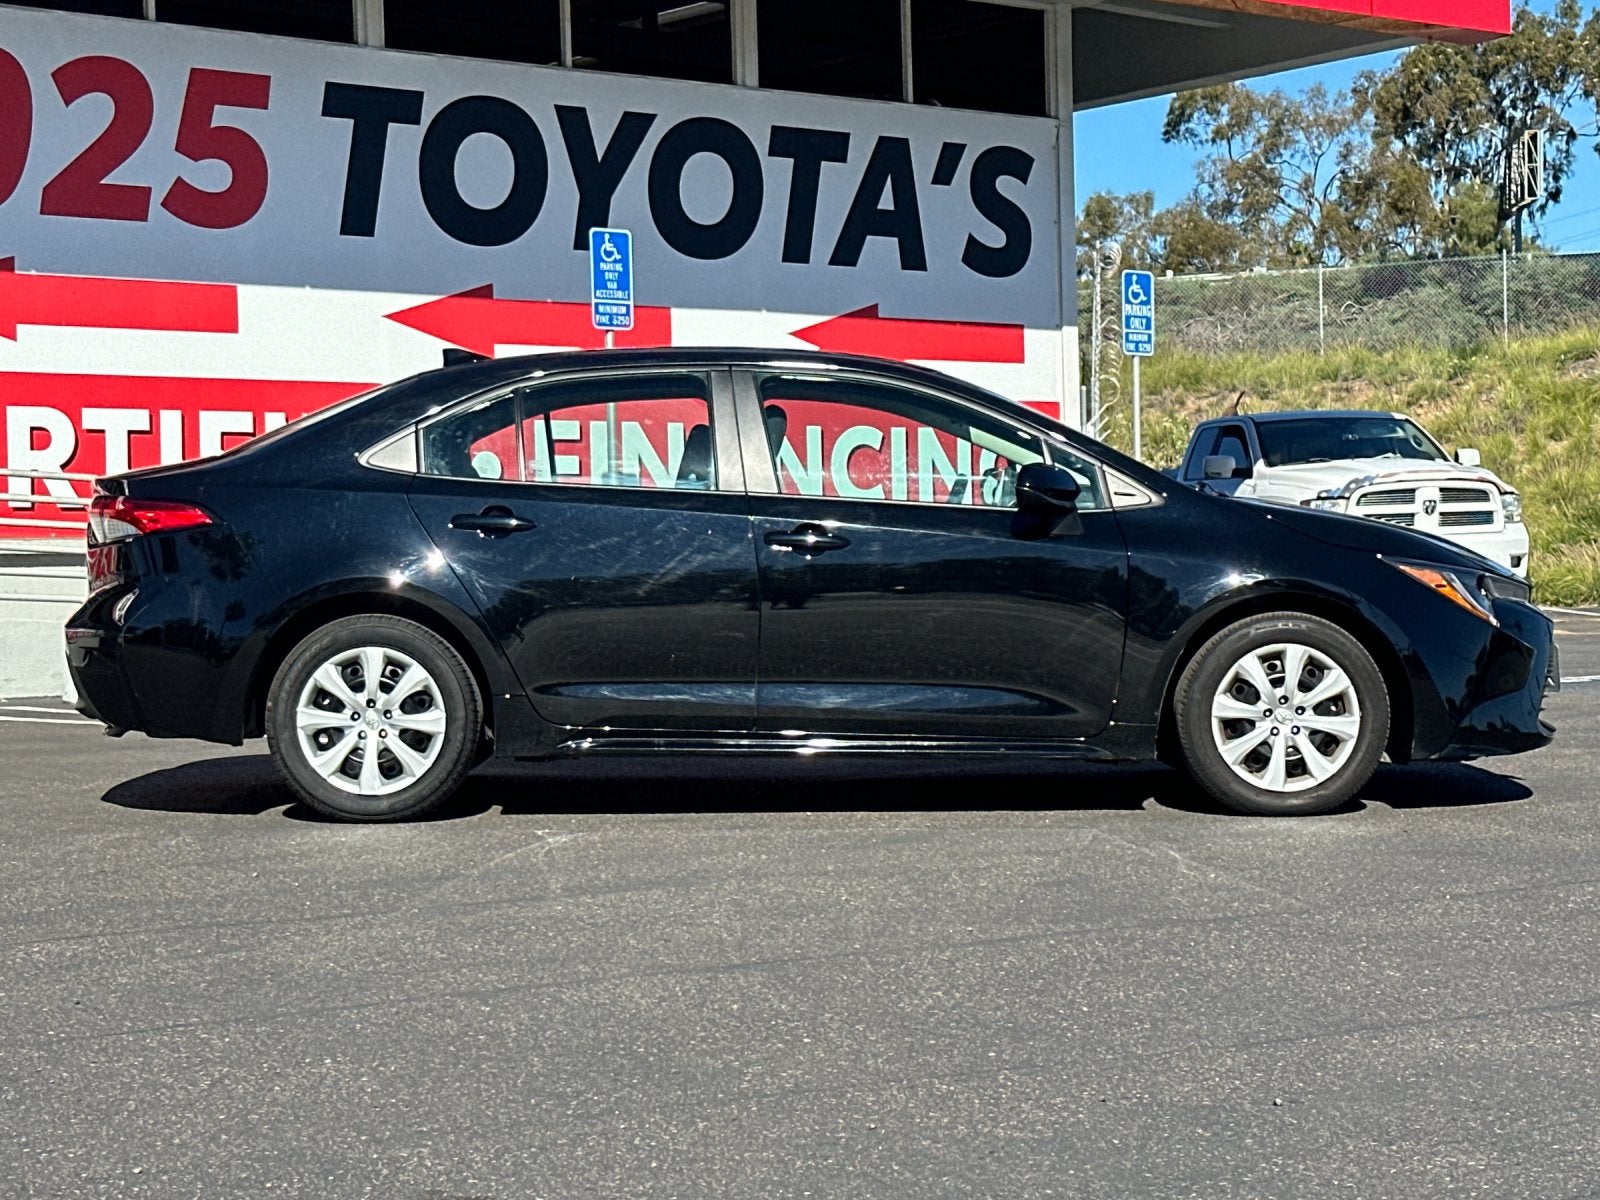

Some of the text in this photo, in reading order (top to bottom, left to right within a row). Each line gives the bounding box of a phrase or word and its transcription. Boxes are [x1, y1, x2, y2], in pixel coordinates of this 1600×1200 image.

[0, 47, 1035, 279] 25 TOYOTA'S
[600, 262, 623, 272] PARKING
[605, 271, 618, 280] ONLY
[607, 281, 617, 289] VAN
[596, 290, 628, 299] ACCESSIBLE
[599, 305, 626, 314] MINIMUM
[1125, 304, 1150, 317] PARKING
[596, 315, 629, 325] FINE $250
[1130, 317, 1146, 329] ONLY
